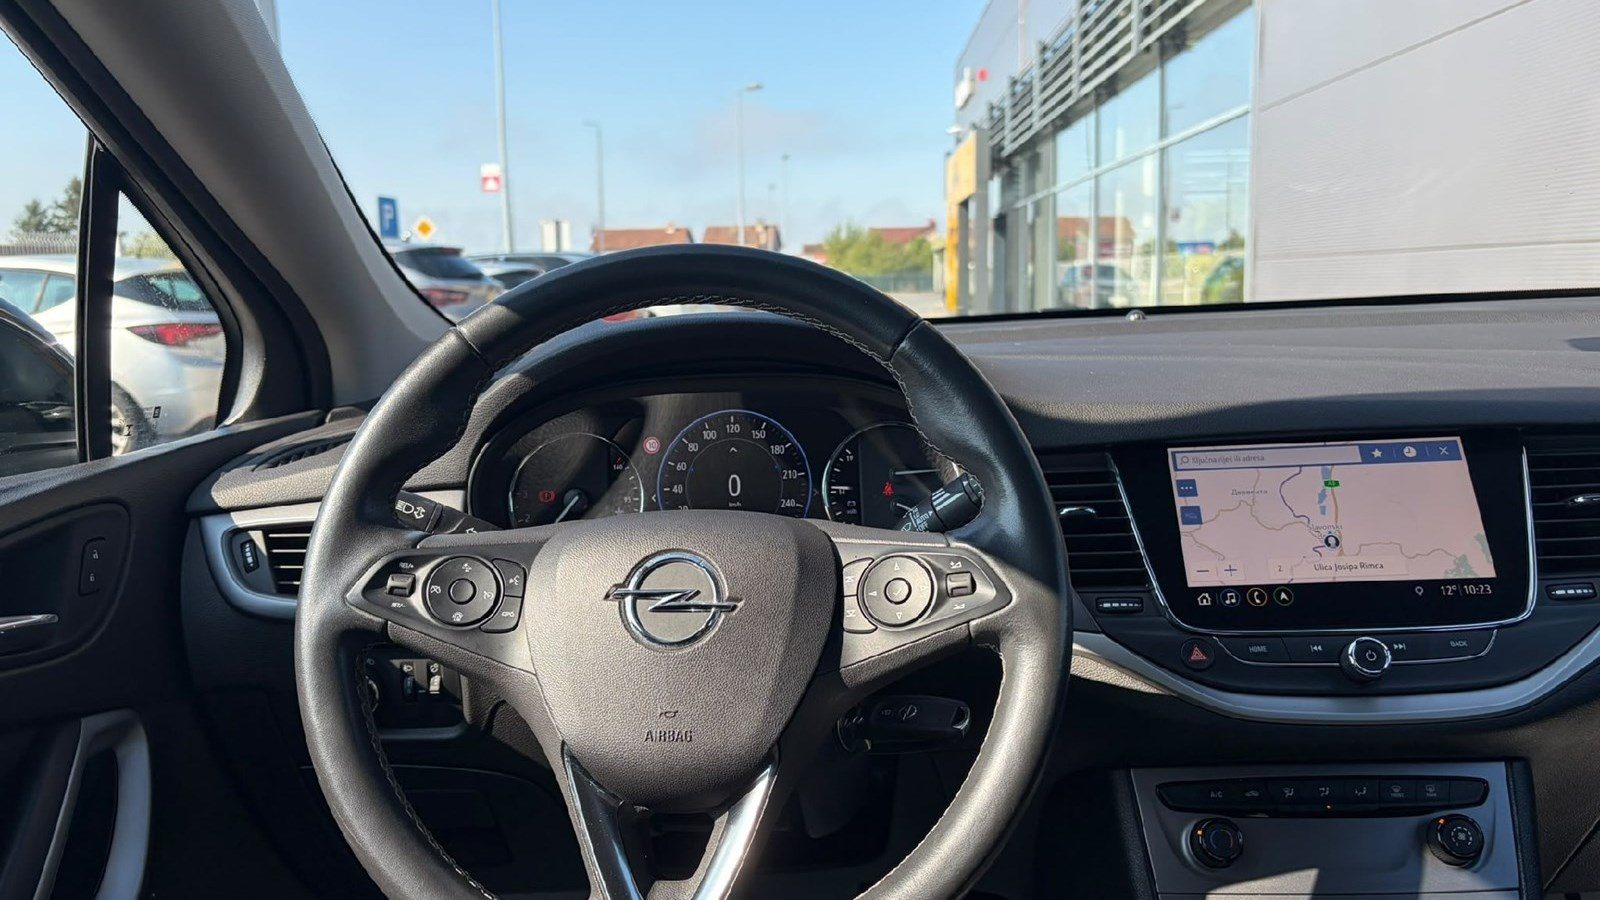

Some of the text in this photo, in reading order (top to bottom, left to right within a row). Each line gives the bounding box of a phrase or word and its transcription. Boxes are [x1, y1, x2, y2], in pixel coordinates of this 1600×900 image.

[382, 202, 394, 231] P
[726, 423, 740, 434] 120
[702, 430, 717, 440] 100
[752, 429, 766, 439] 150
[687, 442, 699, 452] 80
[770, 445, 785, 455] 180
[676, 461, 687, 471] 60
[782, 469, 798, 480] 210
[672, 484, 683, 494] 40
[728, 474, 741, 497] 0
[780, 499, 796, 508] 240
[915, 513, 930, 525] AUTO
[1313, 561, 1384, 572] Ulica Josipa Rimca
[1440, 584, 1492, 596] 12° 10:23
[1248, 645, 1268, 653] HOME
[1449, 640, 1468, 648] BACK
[643, 728, 693, 743] AIRBAG
